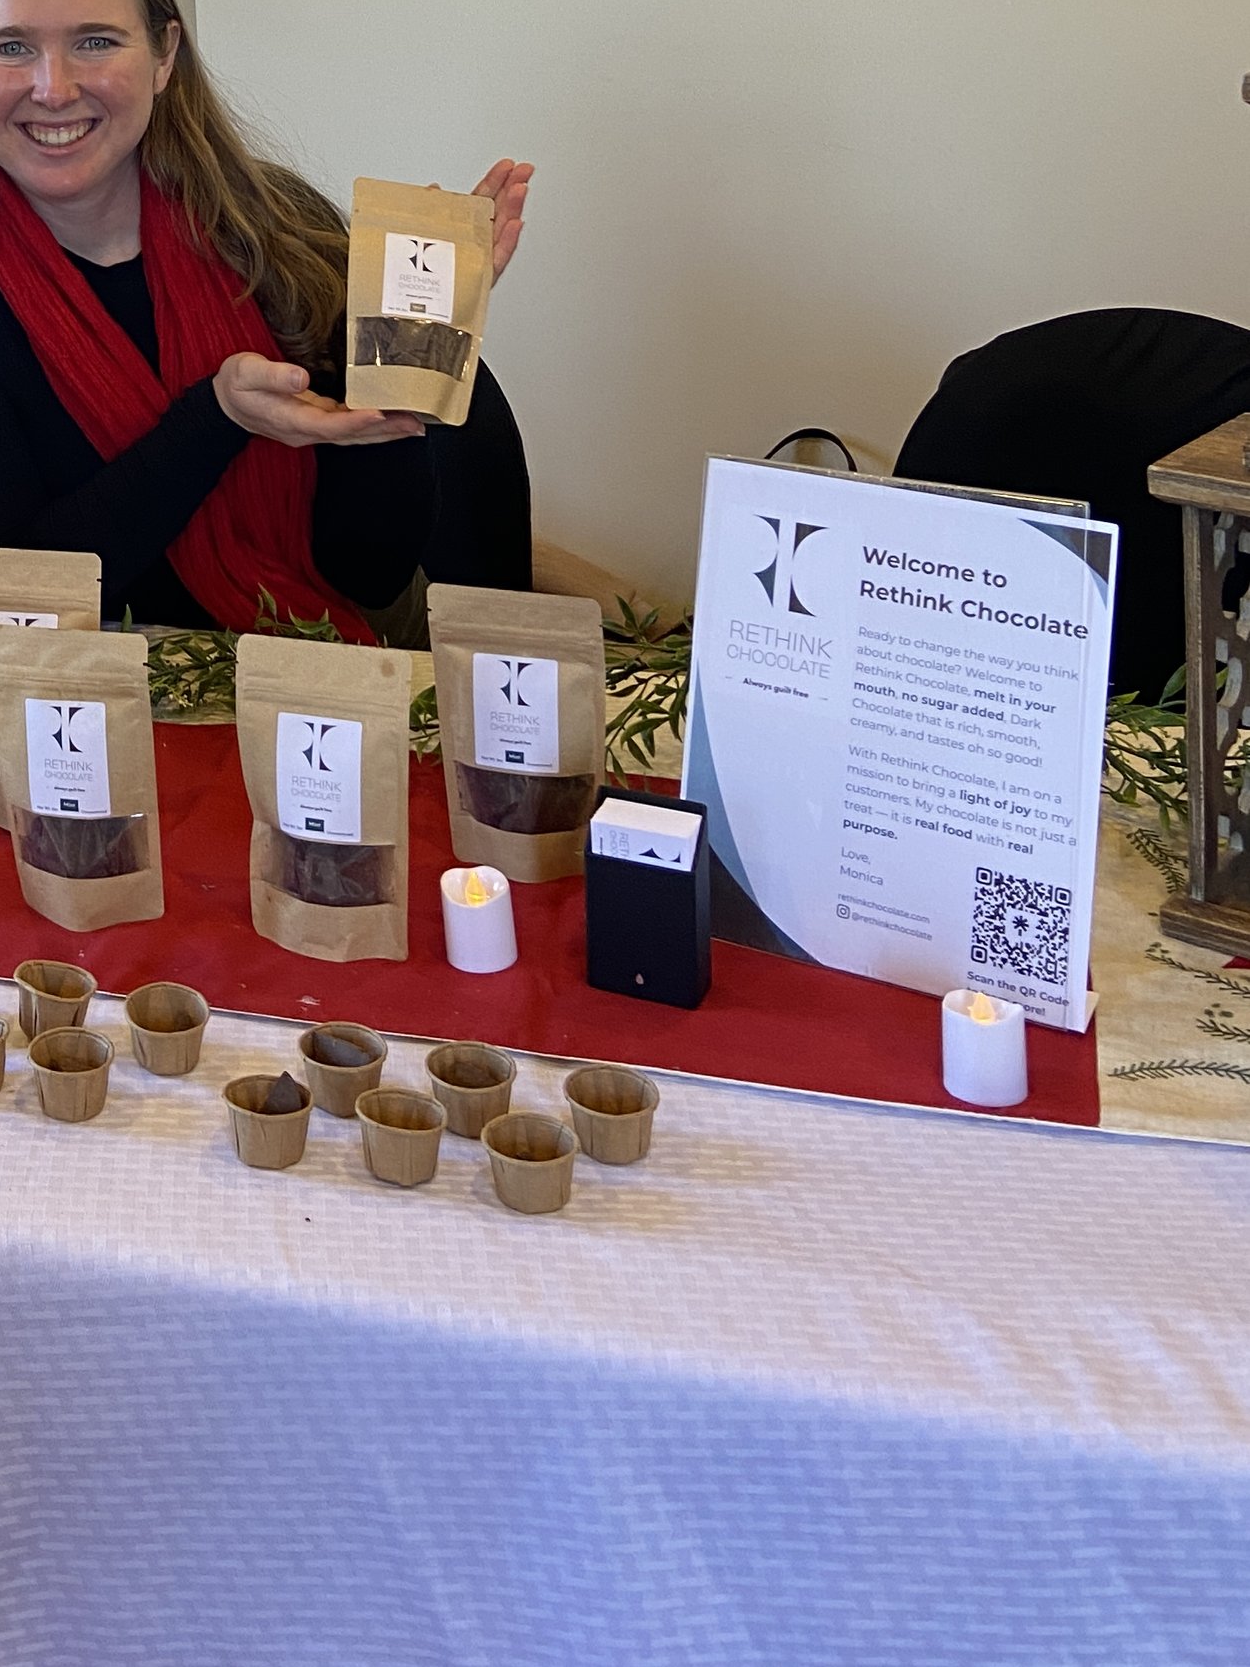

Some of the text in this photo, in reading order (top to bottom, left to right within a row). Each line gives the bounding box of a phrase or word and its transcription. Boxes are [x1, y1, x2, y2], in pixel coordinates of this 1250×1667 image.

[862, 546, 1007, 588] Welcome to
[859, 579, 1088, 639] Rethink Chocolate
[729, 619, 832, 659] RETHINK
[858, 625, 1078, 681] Ready to change the way you think
[726, 643, 830, 679] CHOCOLATE
[856, 645, 1042, 692] about chocolate? Welcome to
[742, 677, 809, 698] Always guilt free
[853, 682, 1041, 729] mouth, no sugar added, Dark
[855, 661, 1056, 713] Rethink Chocolate, melt in your
[489, 722, 541, 736] CHOCOLATE
[490, 710, 541, 726] RETHINK
[852, 697, 1040, 750] Chocolate that is rich, smooth,
[849, 717, 1042, 767] creamy, and tastes oh so good!
[43, 769, 94, 782] CHOCOLATE
[44, 757, 94, 772] RETHINK
[848, 744, 877, 760] With
[880, 752, 929, 773] Rethink
[931, 764, 998, 791] Chocolate,
[1008, 784, 1030, 796] am
[1033, 790, 1051, 801] on
[1053, 795, 1062, 804] a
[290, 787, 343, 803] CHOCOLATE
[291, 775, 343, 793] RETHINK
[846, 764, 1073, 828] mission to bring a light of joy to my
[842, 819, 897, 839] purpose.
[843, 799, 1033, 854] treat it is real food with real
[845, 782, 1076, 846] customers. My chocolate is not just a
[841, 846, 870, 865] Love,
[839, 864, 883, 886] Monica
[966, 970, 994, 986] Scan
[997, 979, 1016, 992] the
[1019, 985, 1036, 997] QR
[1039, 991, 1069, 1007] Code
[1012, 1000, 1046, 1016] ore!
